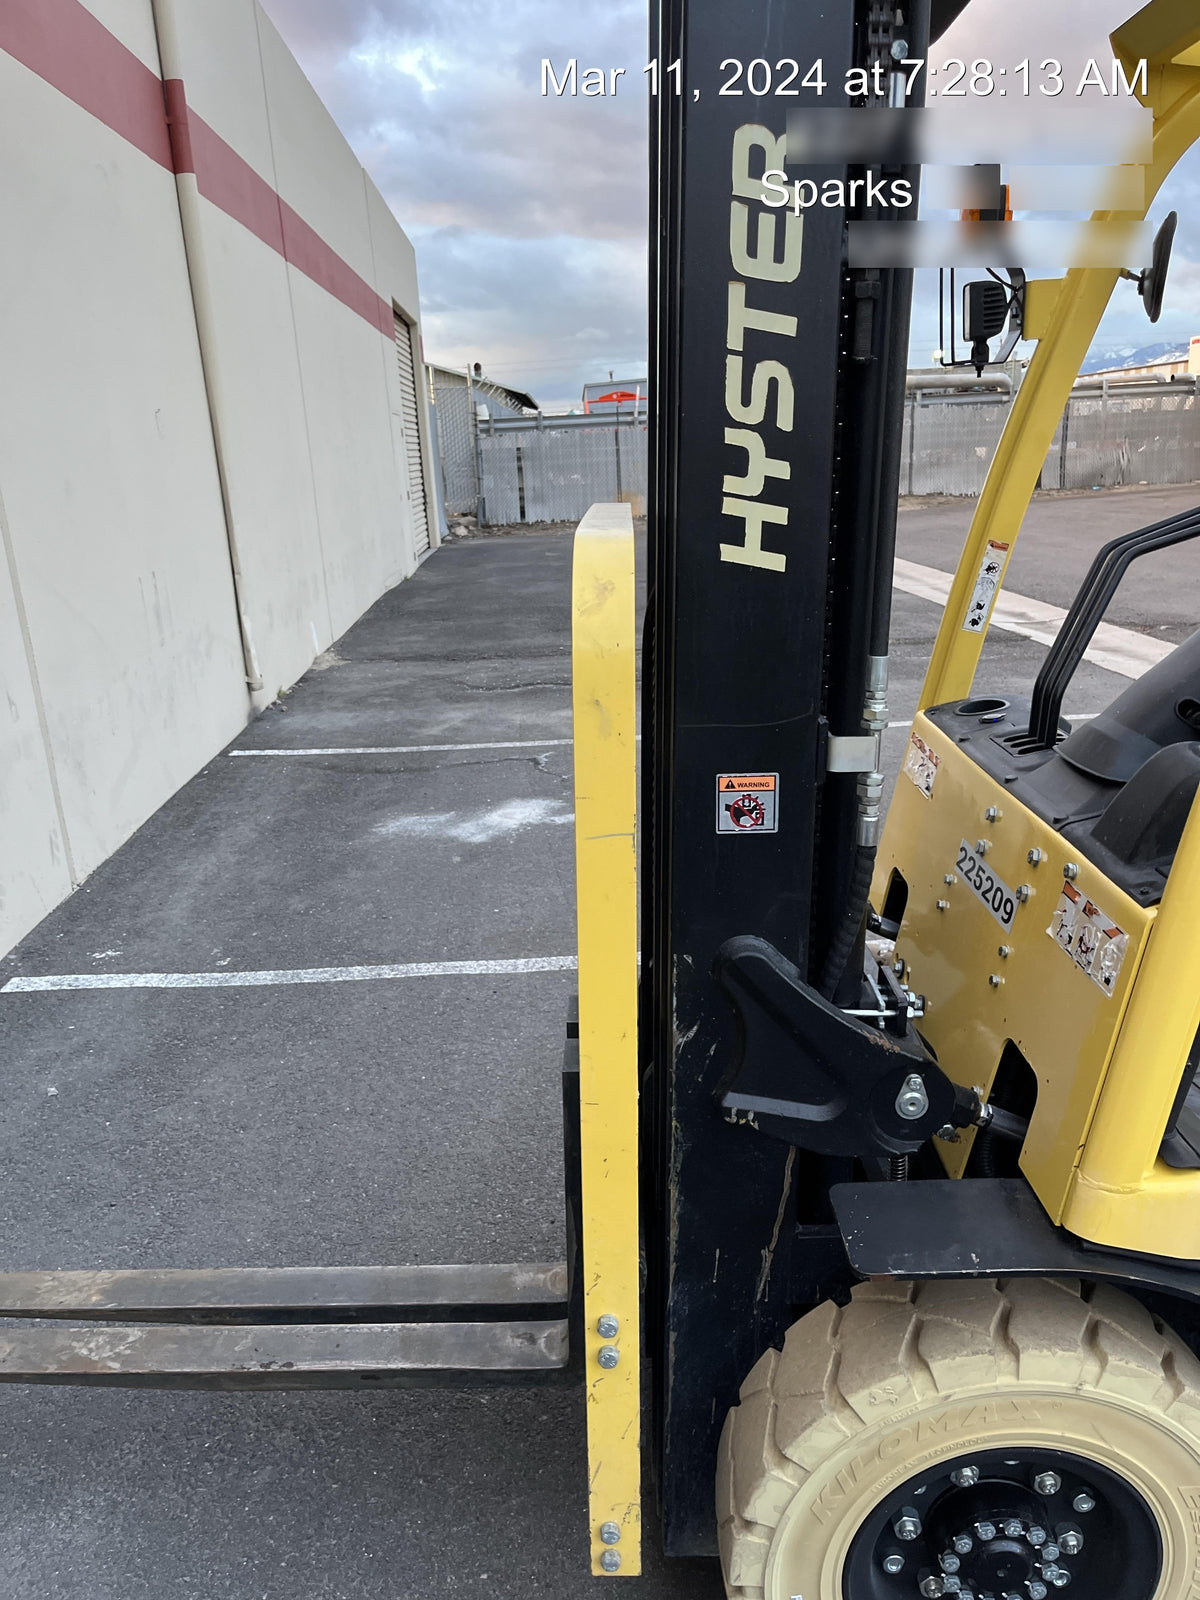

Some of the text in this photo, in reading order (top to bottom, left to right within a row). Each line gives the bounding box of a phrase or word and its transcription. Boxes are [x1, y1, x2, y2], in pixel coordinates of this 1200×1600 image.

[719, 123, 805, 573] HYSTER
[737, 781, 771, 789] WARNING
[955, 846, 1015, 926] 225209
